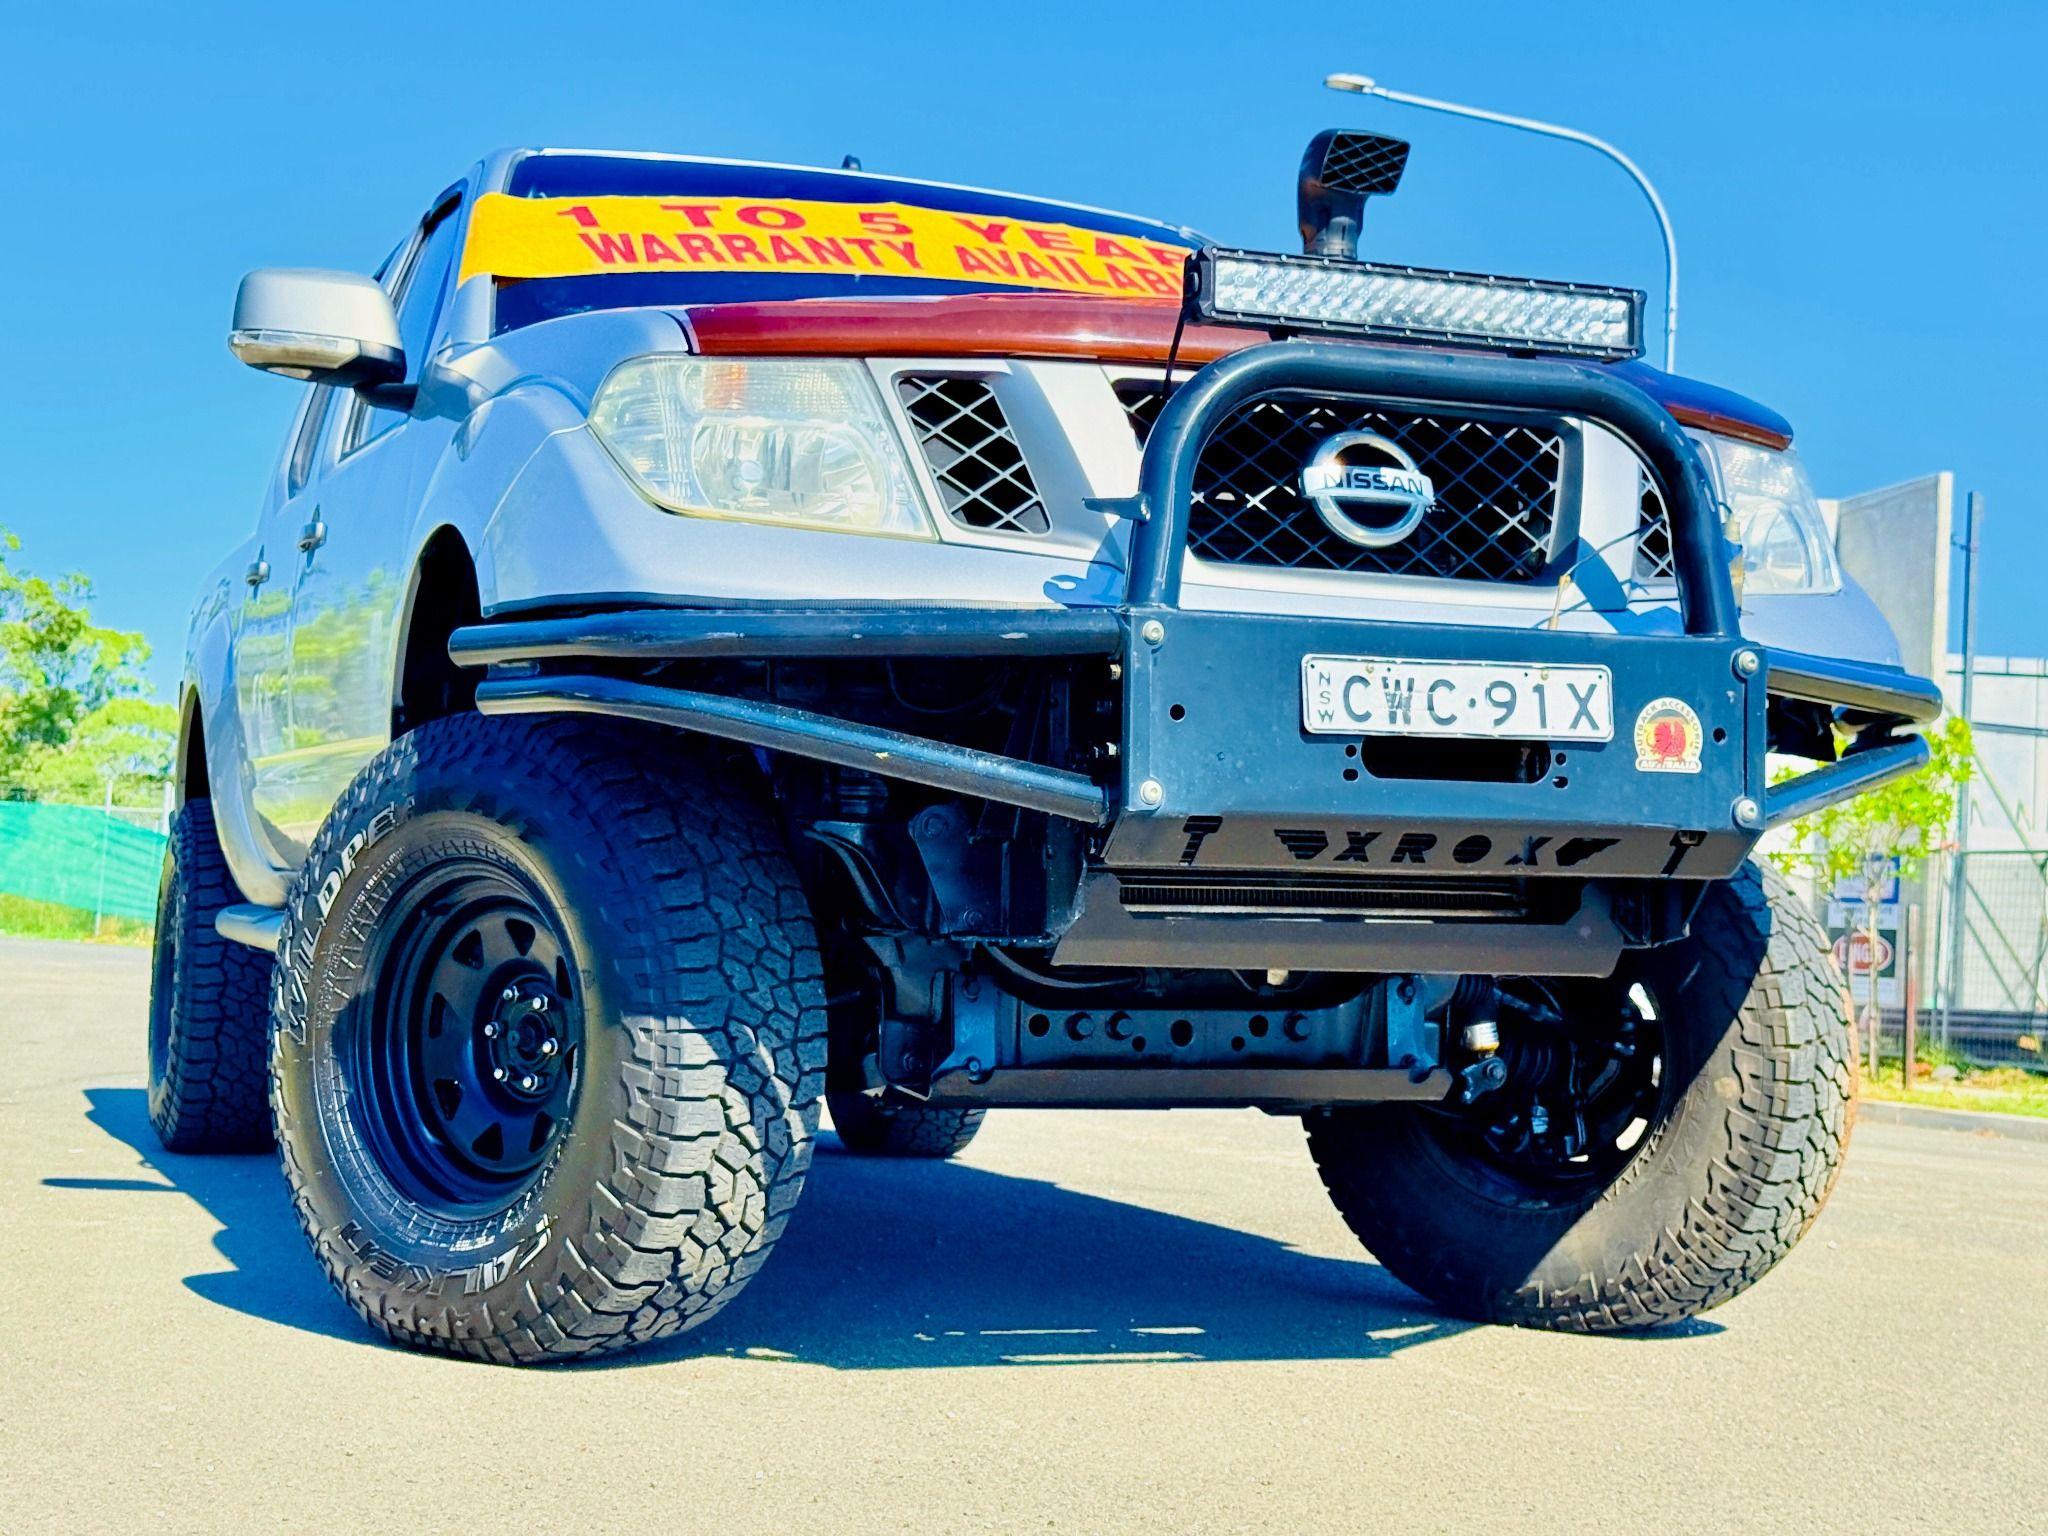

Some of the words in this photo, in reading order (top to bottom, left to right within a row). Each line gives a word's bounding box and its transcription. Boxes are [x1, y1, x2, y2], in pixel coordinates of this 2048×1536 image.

[556, 206, 600, 228] 1
[660, 204, 806, 229] TO
[859, 211, 914, 236] 5
[578, 233, 922, 269] WARRANTY
[1324, 472, 1424, 496] NISSAN
[1637, 703, 1658, 757] OUTBACK
[1333, 830, 1553, 867] XROX
